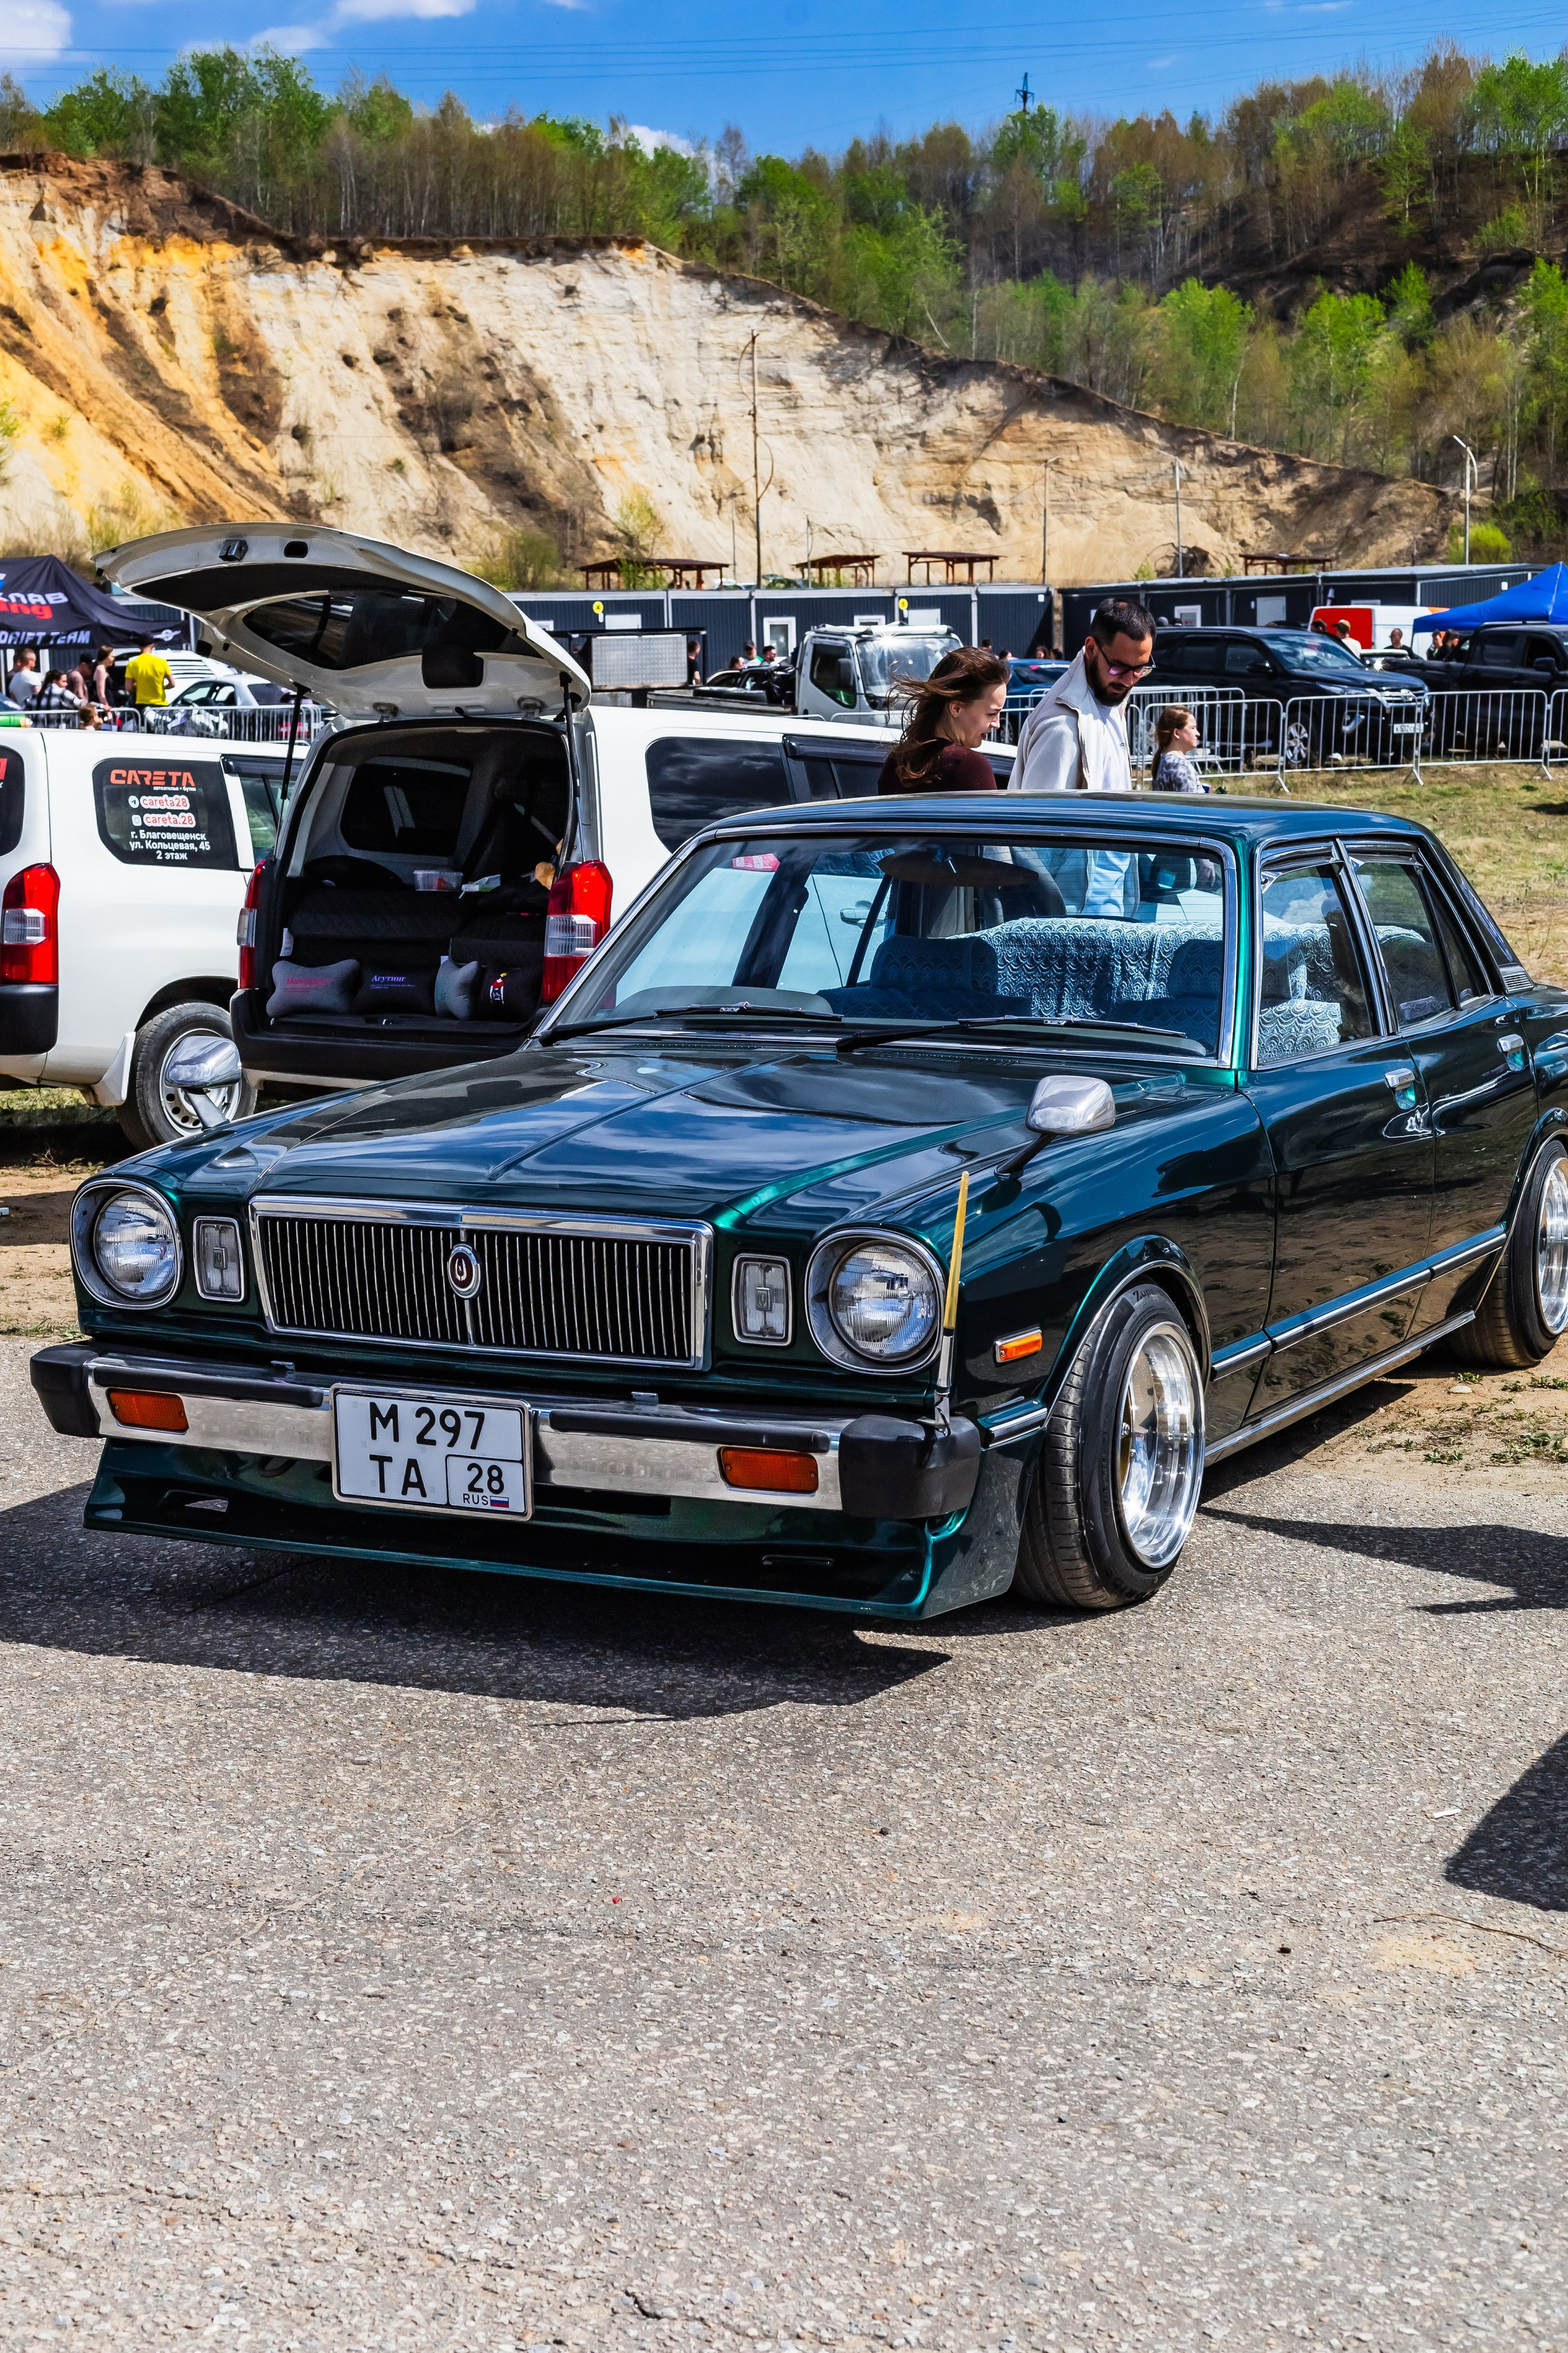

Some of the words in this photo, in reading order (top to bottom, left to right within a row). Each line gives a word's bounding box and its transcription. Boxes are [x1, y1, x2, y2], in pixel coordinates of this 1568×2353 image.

[0, 630, 46, 645] DRIFT
[49, 630, 91, 644] TEAM
[110, 769, 195, 787] CARETA
[142, 797, 187, 807] careta28
[145, 815, 194, 825] careta.28
[139, 829, 206, 841] Благовещенск
[129, 841, 144, 851] ул.
[145, 840, 198, 852] Кольцевая,
[199, 841, 211, 850] 45
[156, 850, 162, 859] 2
[369, 1402, 399, 1443] M
[415, 1407, 485, 1450] 297
[467, 1462, 504, 1495] 28
[462, 1493, 488, 1506] RUS
